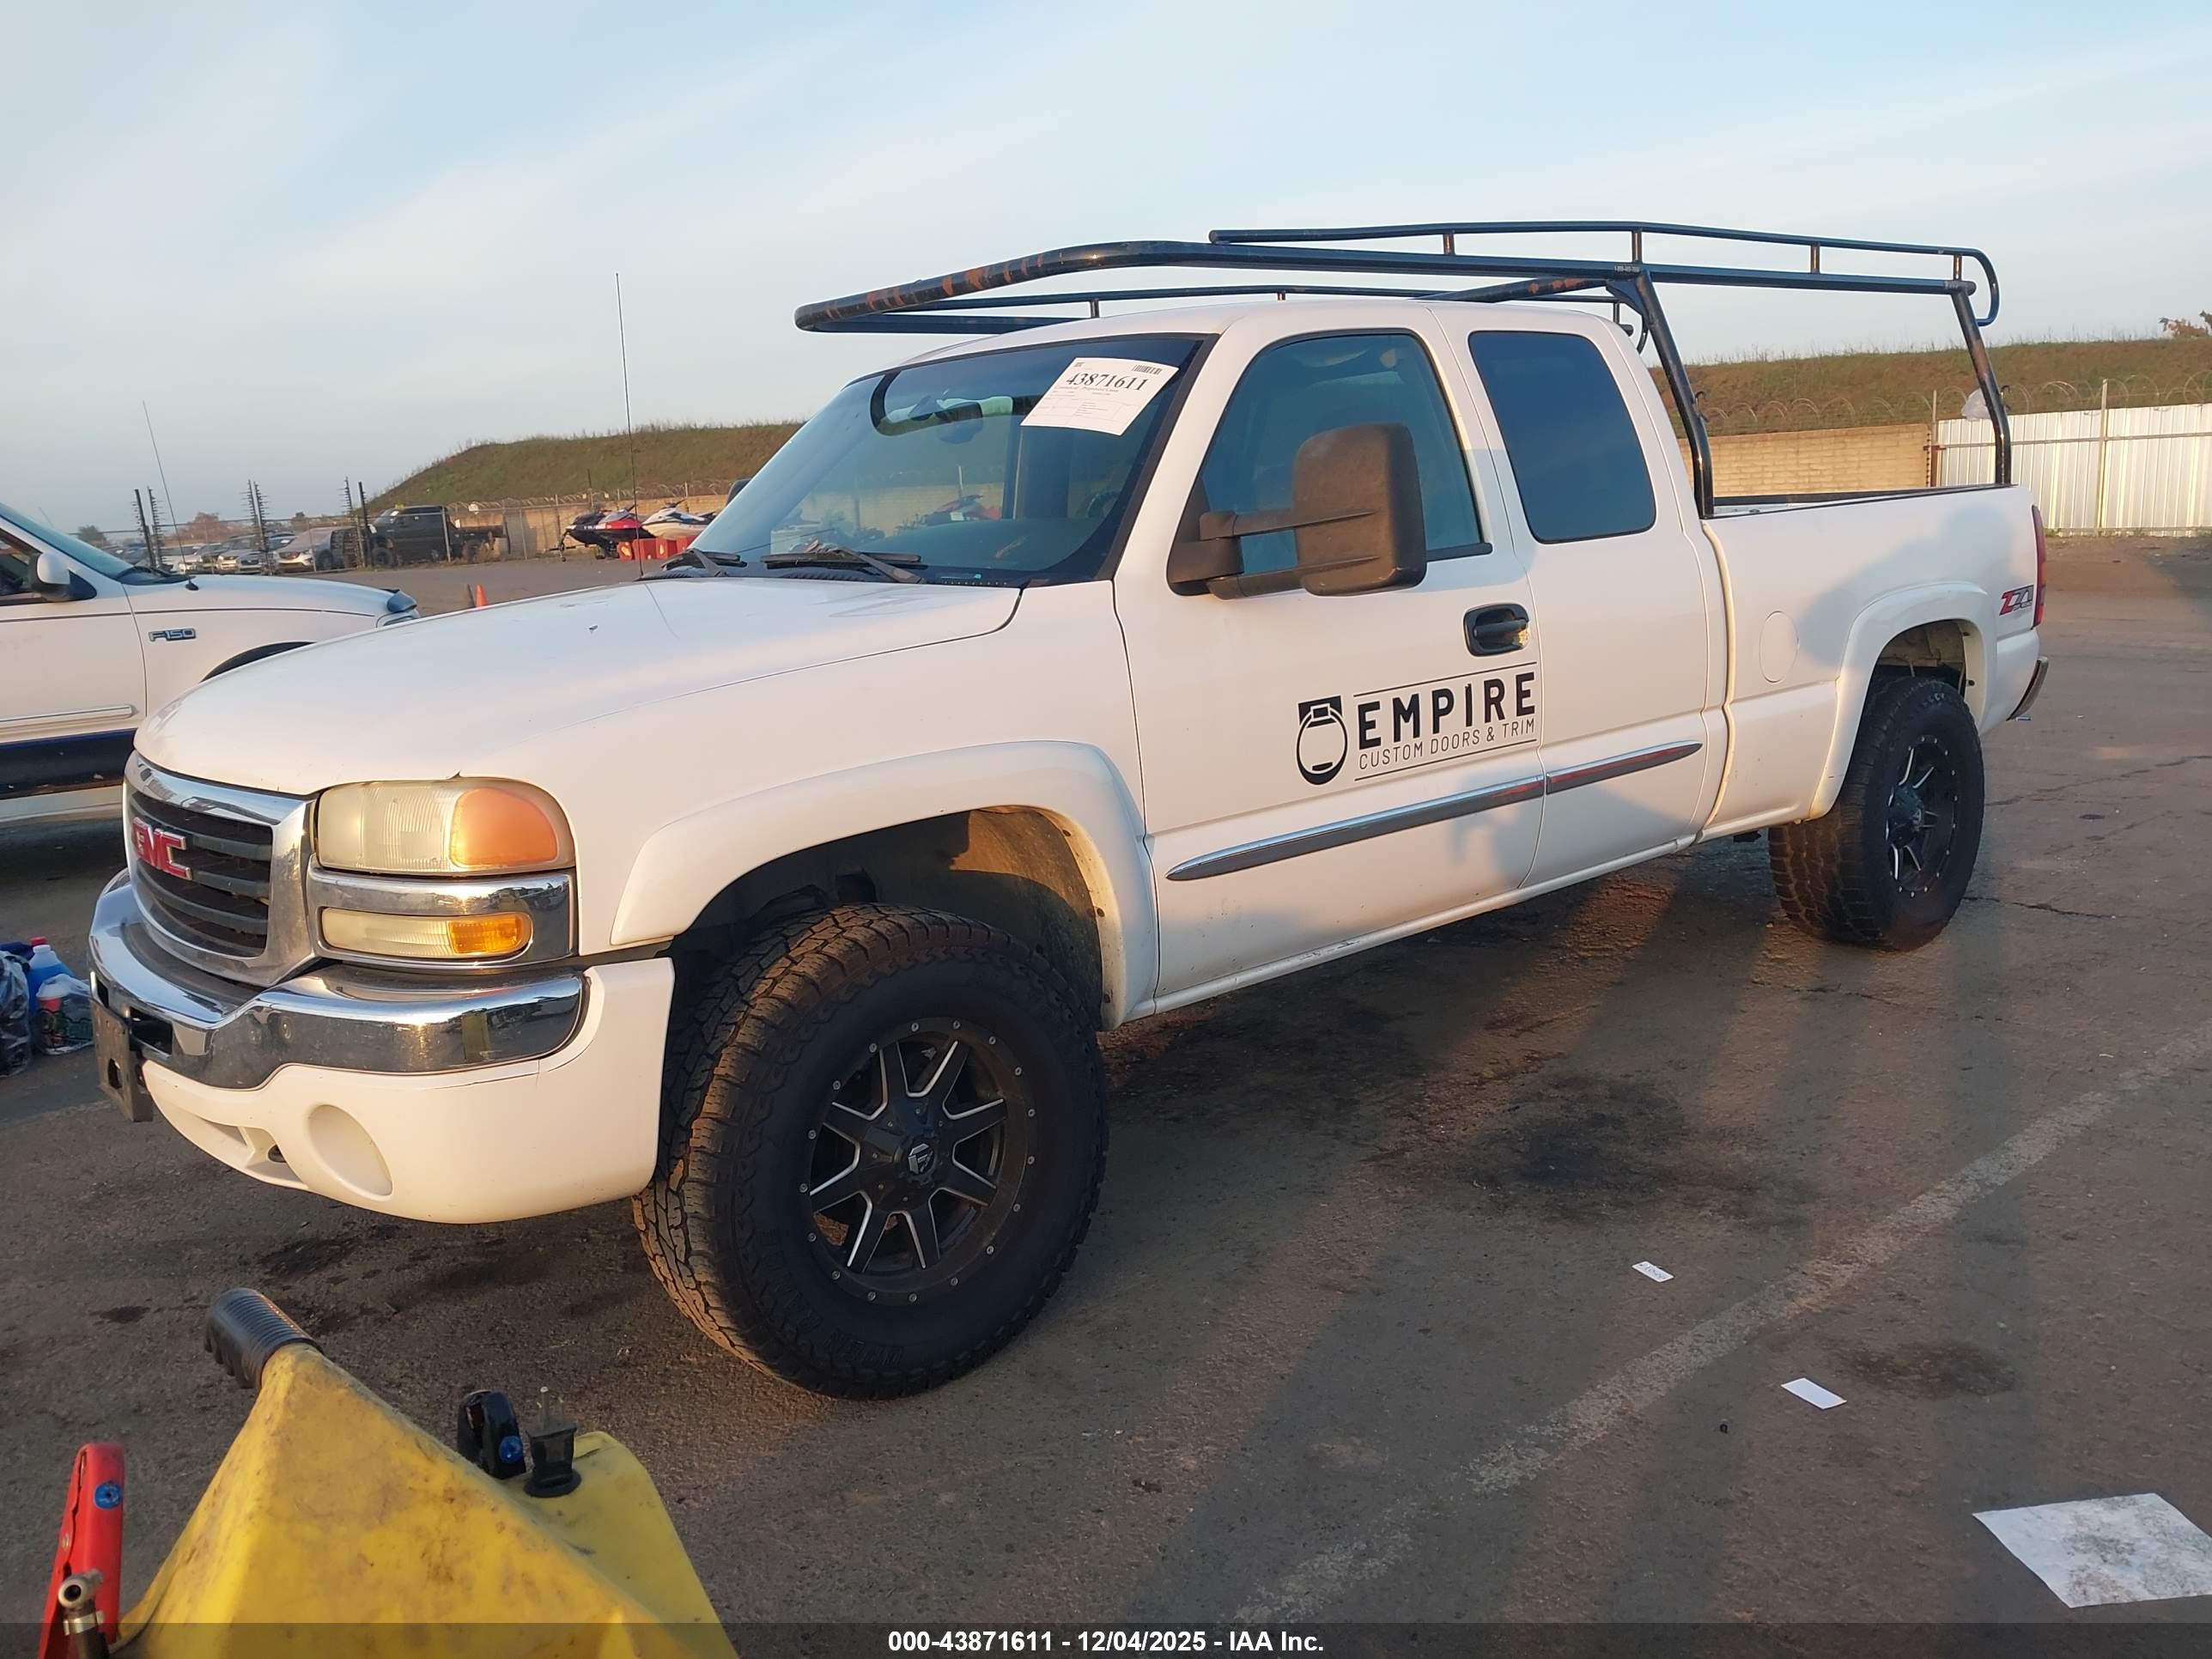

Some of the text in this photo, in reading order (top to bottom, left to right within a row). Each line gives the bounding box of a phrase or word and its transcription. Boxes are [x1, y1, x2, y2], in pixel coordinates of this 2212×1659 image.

[1066, 372, 1151, 391] 43871611
[1358, 672, 1535, 750] EMPIRE
[1359, 719, 1534, 770] CUSTOM DOORS & TRIM
[132, 817, 192, 881] GMC
